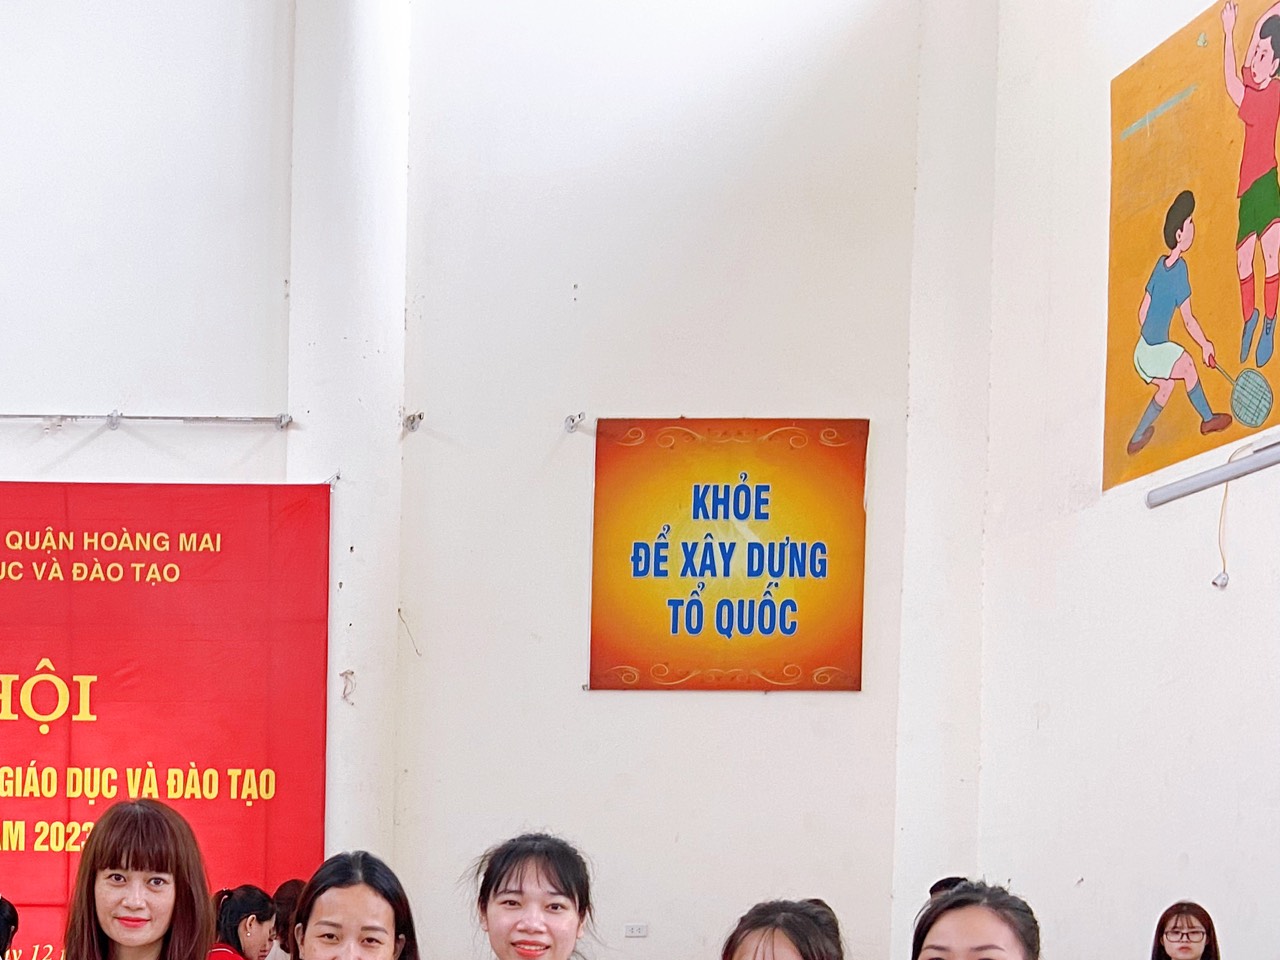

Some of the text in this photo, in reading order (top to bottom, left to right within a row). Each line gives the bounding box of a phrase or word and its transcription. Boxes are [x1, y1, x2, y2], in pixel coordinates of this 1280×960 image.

[691, 471, 771, 521] KHỎE
[5, 526, 74, 554] QUẬN
[83, 527, 170, 552] HOÀNG
[178, 532, 222, 553] MAI
[630, 523, 828, 587] ĐỂ XÂY DỰNG
[32, 557, 64, 582] VÀ
[72, 557, 124, 583] ĐÀO
[131, 562, 181, 586] TẠO
[667, 581, 798, 640] TỔ QUỐC
[66, 767, 118, 805] DỤC
[125, 761, 159, 799] VÀ
[166, 761, 219, 800] ĐÀO
[227, 768, 276, 807] TẠO
